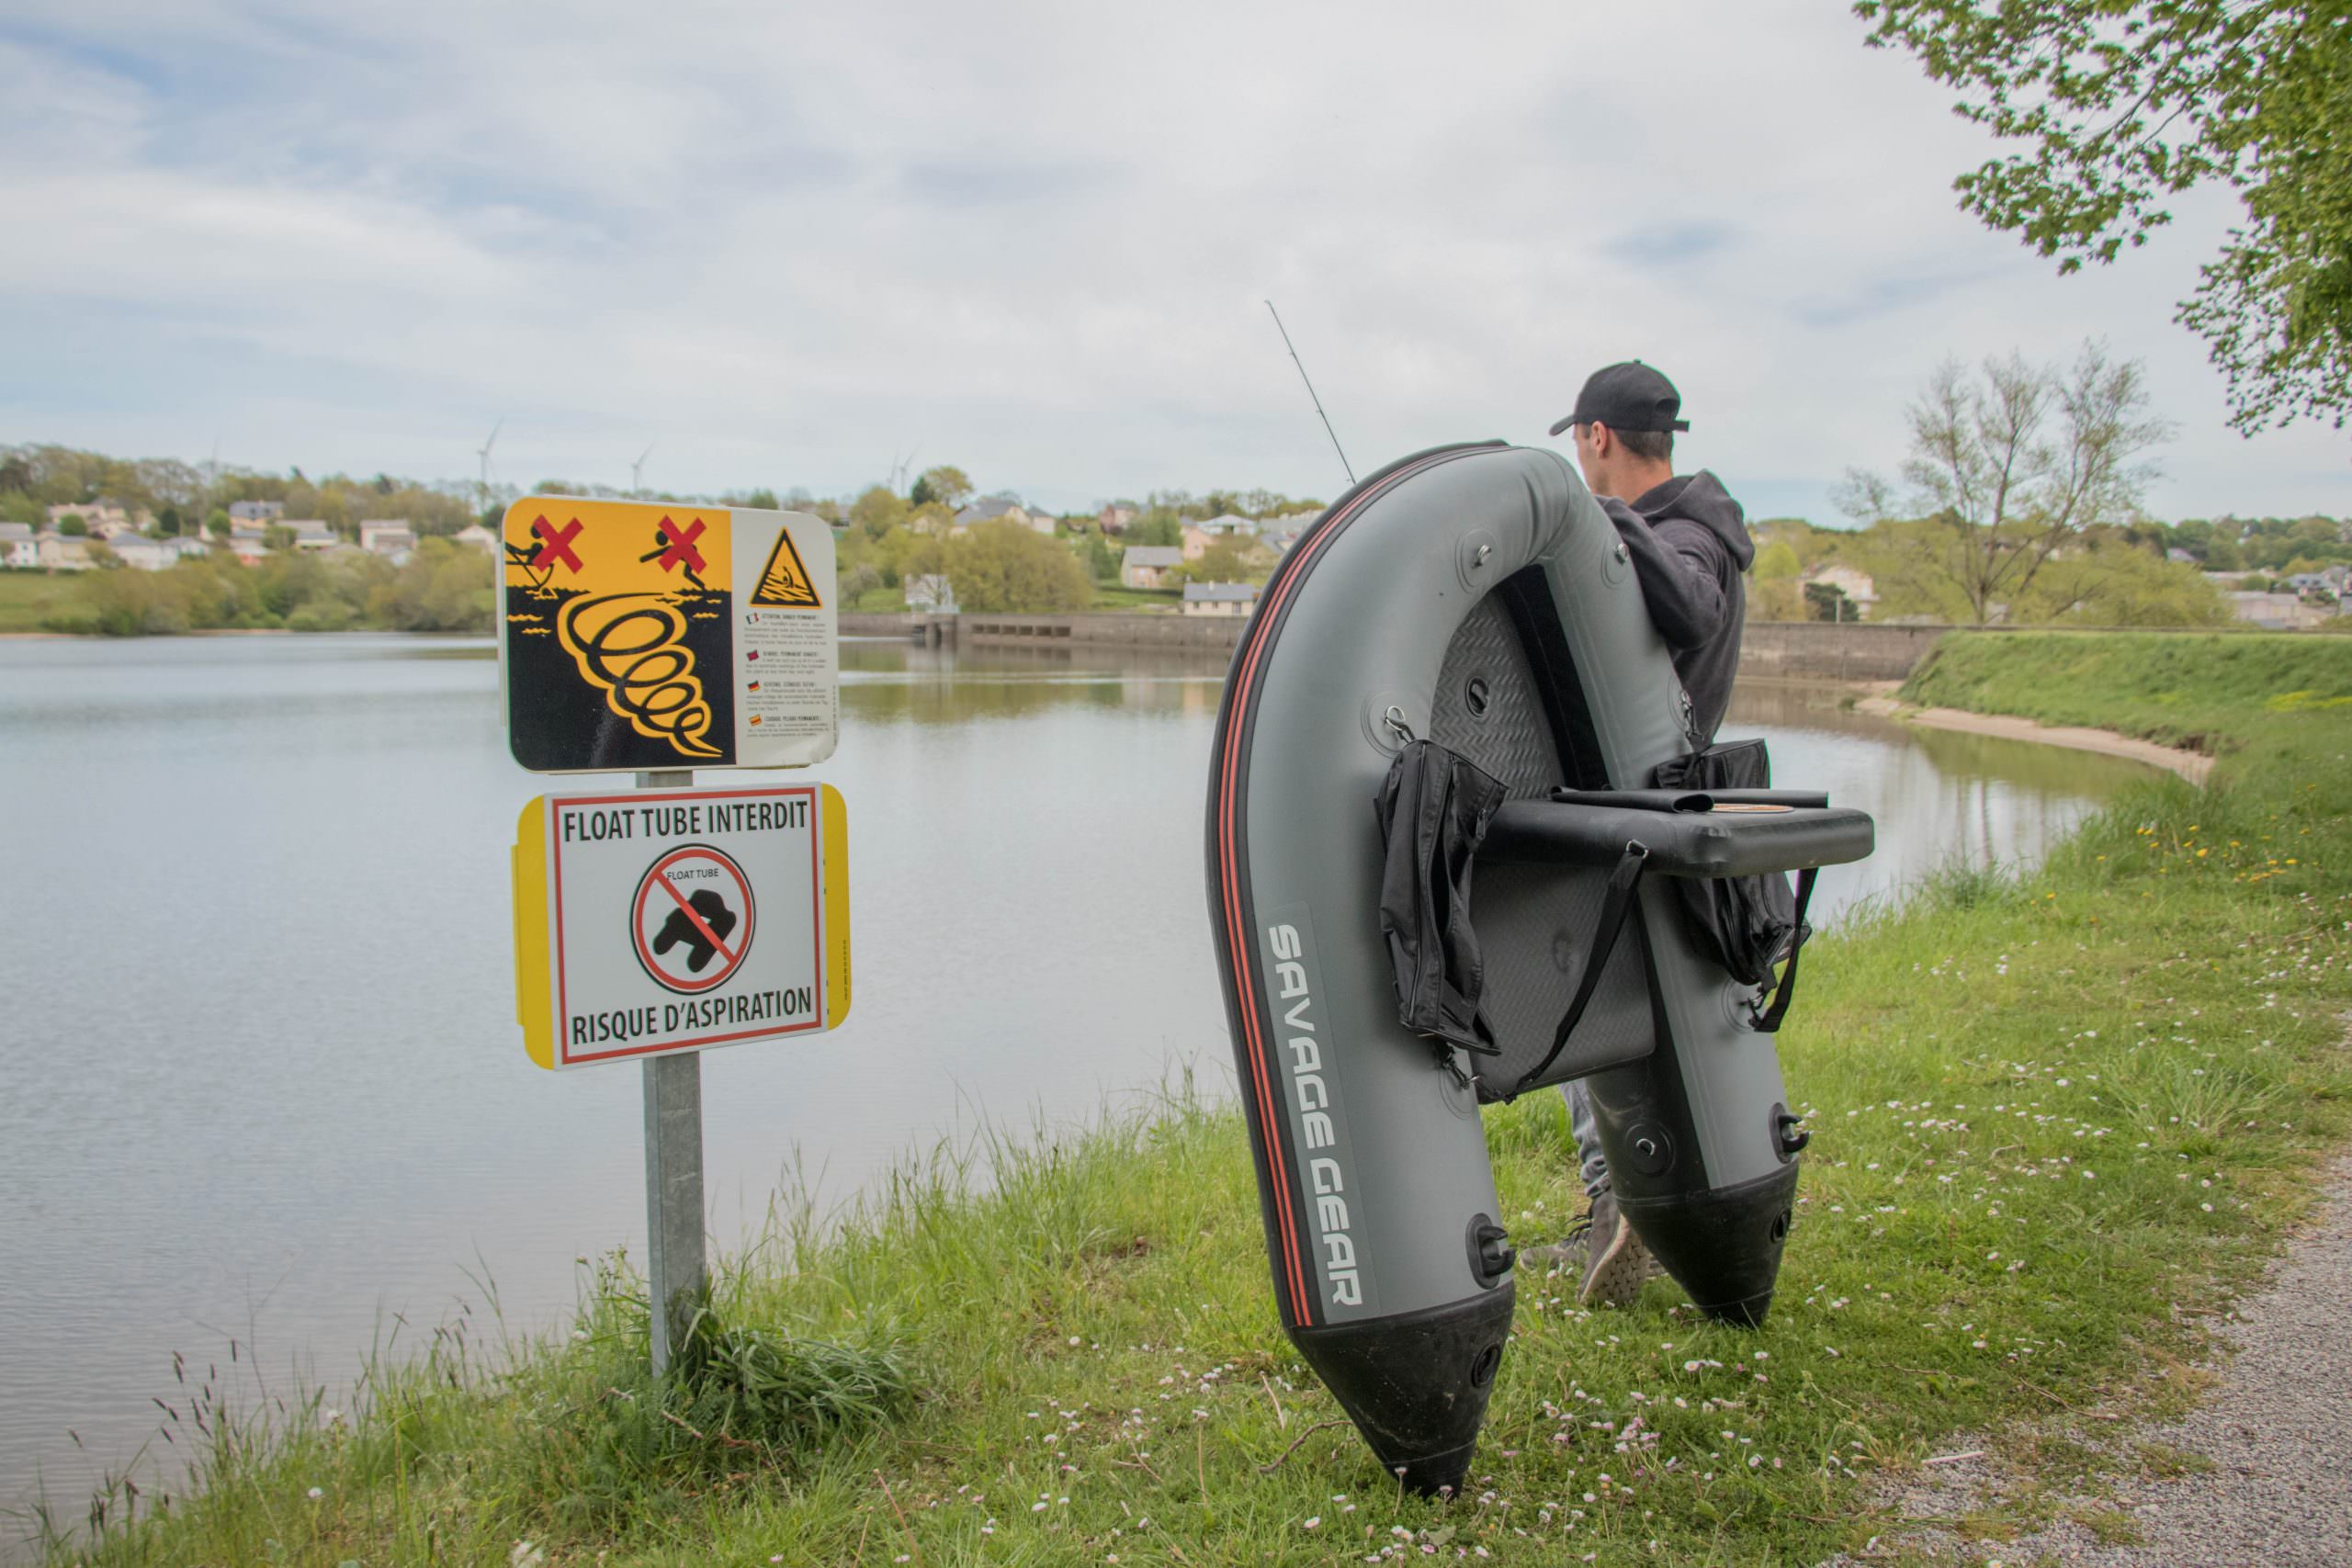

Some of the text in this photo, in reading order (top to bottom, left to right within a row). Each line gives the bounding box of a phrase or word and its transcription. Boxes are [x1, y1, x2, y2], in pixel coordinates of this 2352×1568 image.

[564, 800, 808, 842] FLOAT TUBE INTERDIT
[667, 868, 719, 881] FLOAT TUBE
[571, 986, 812, 1045] RISQUE D'ASPIRATION
[1268, 923, 1363, 1307] SAVAGE GEAR
